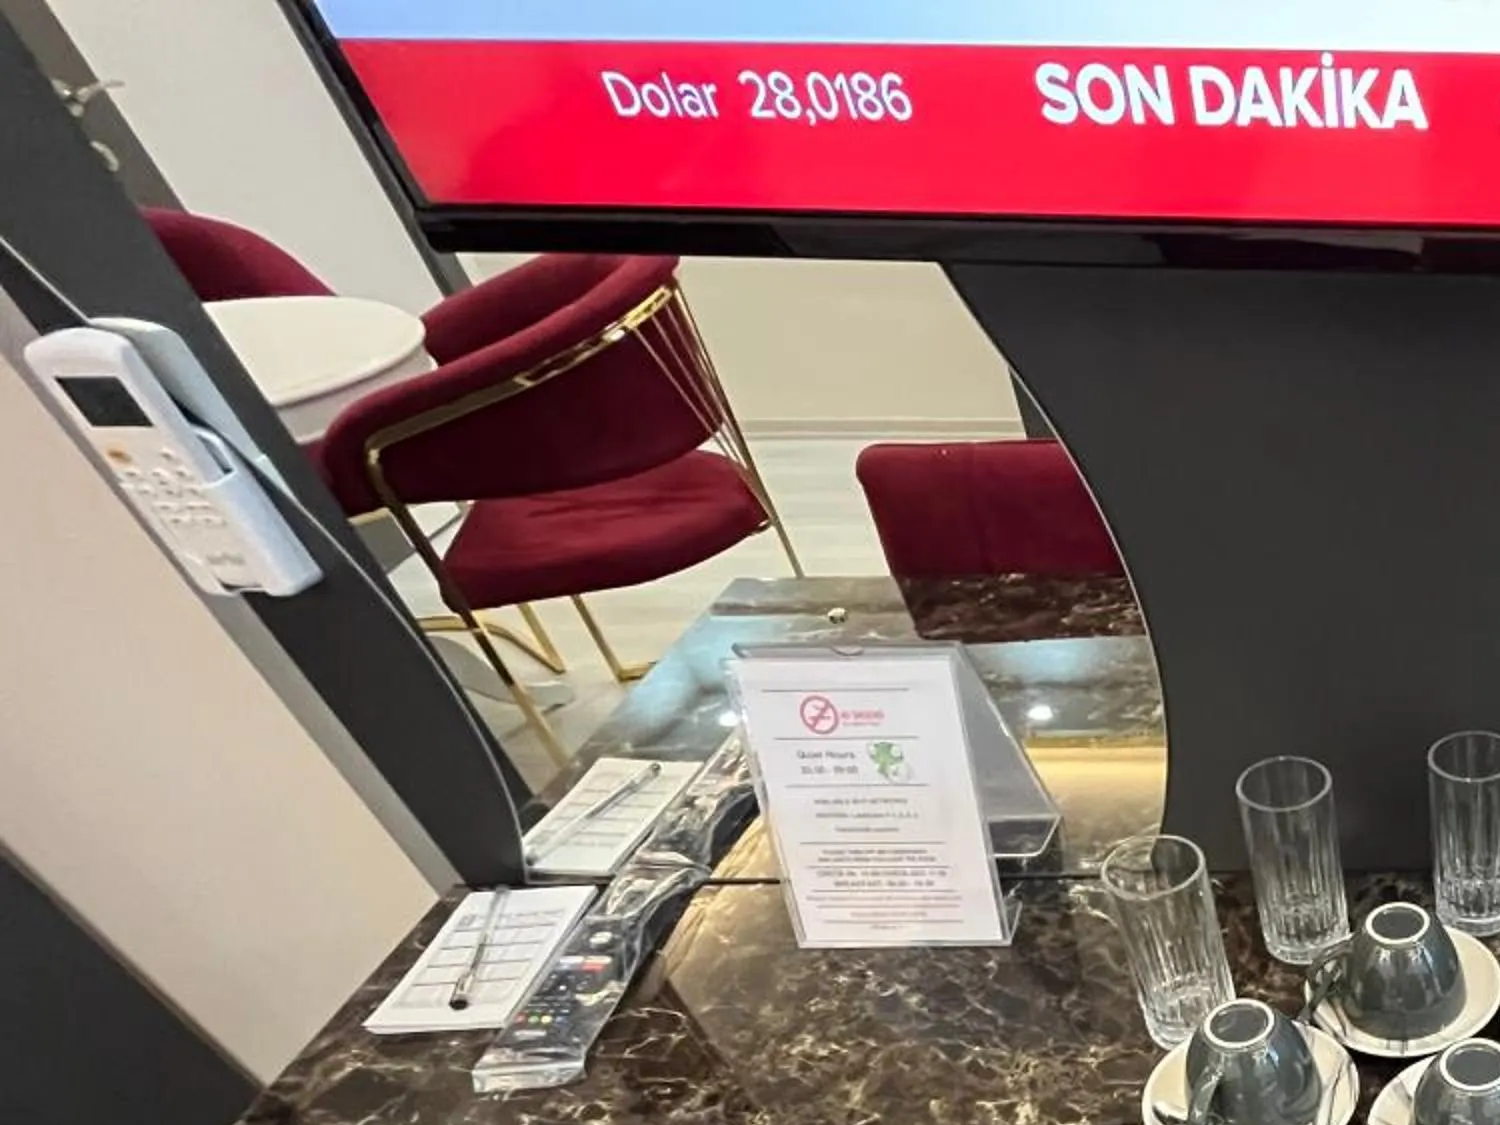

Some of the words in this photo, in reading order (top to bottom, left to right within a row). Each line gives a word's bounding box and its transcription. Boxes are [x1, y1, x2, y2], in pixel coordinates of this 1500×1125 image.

[602, 72, 719, 118] Dolar
[738, 70, 913, 125] 28,0186
[1035, 63, 1176, 127] SON
[1189, 51, 1429, 132] DAKİKA
